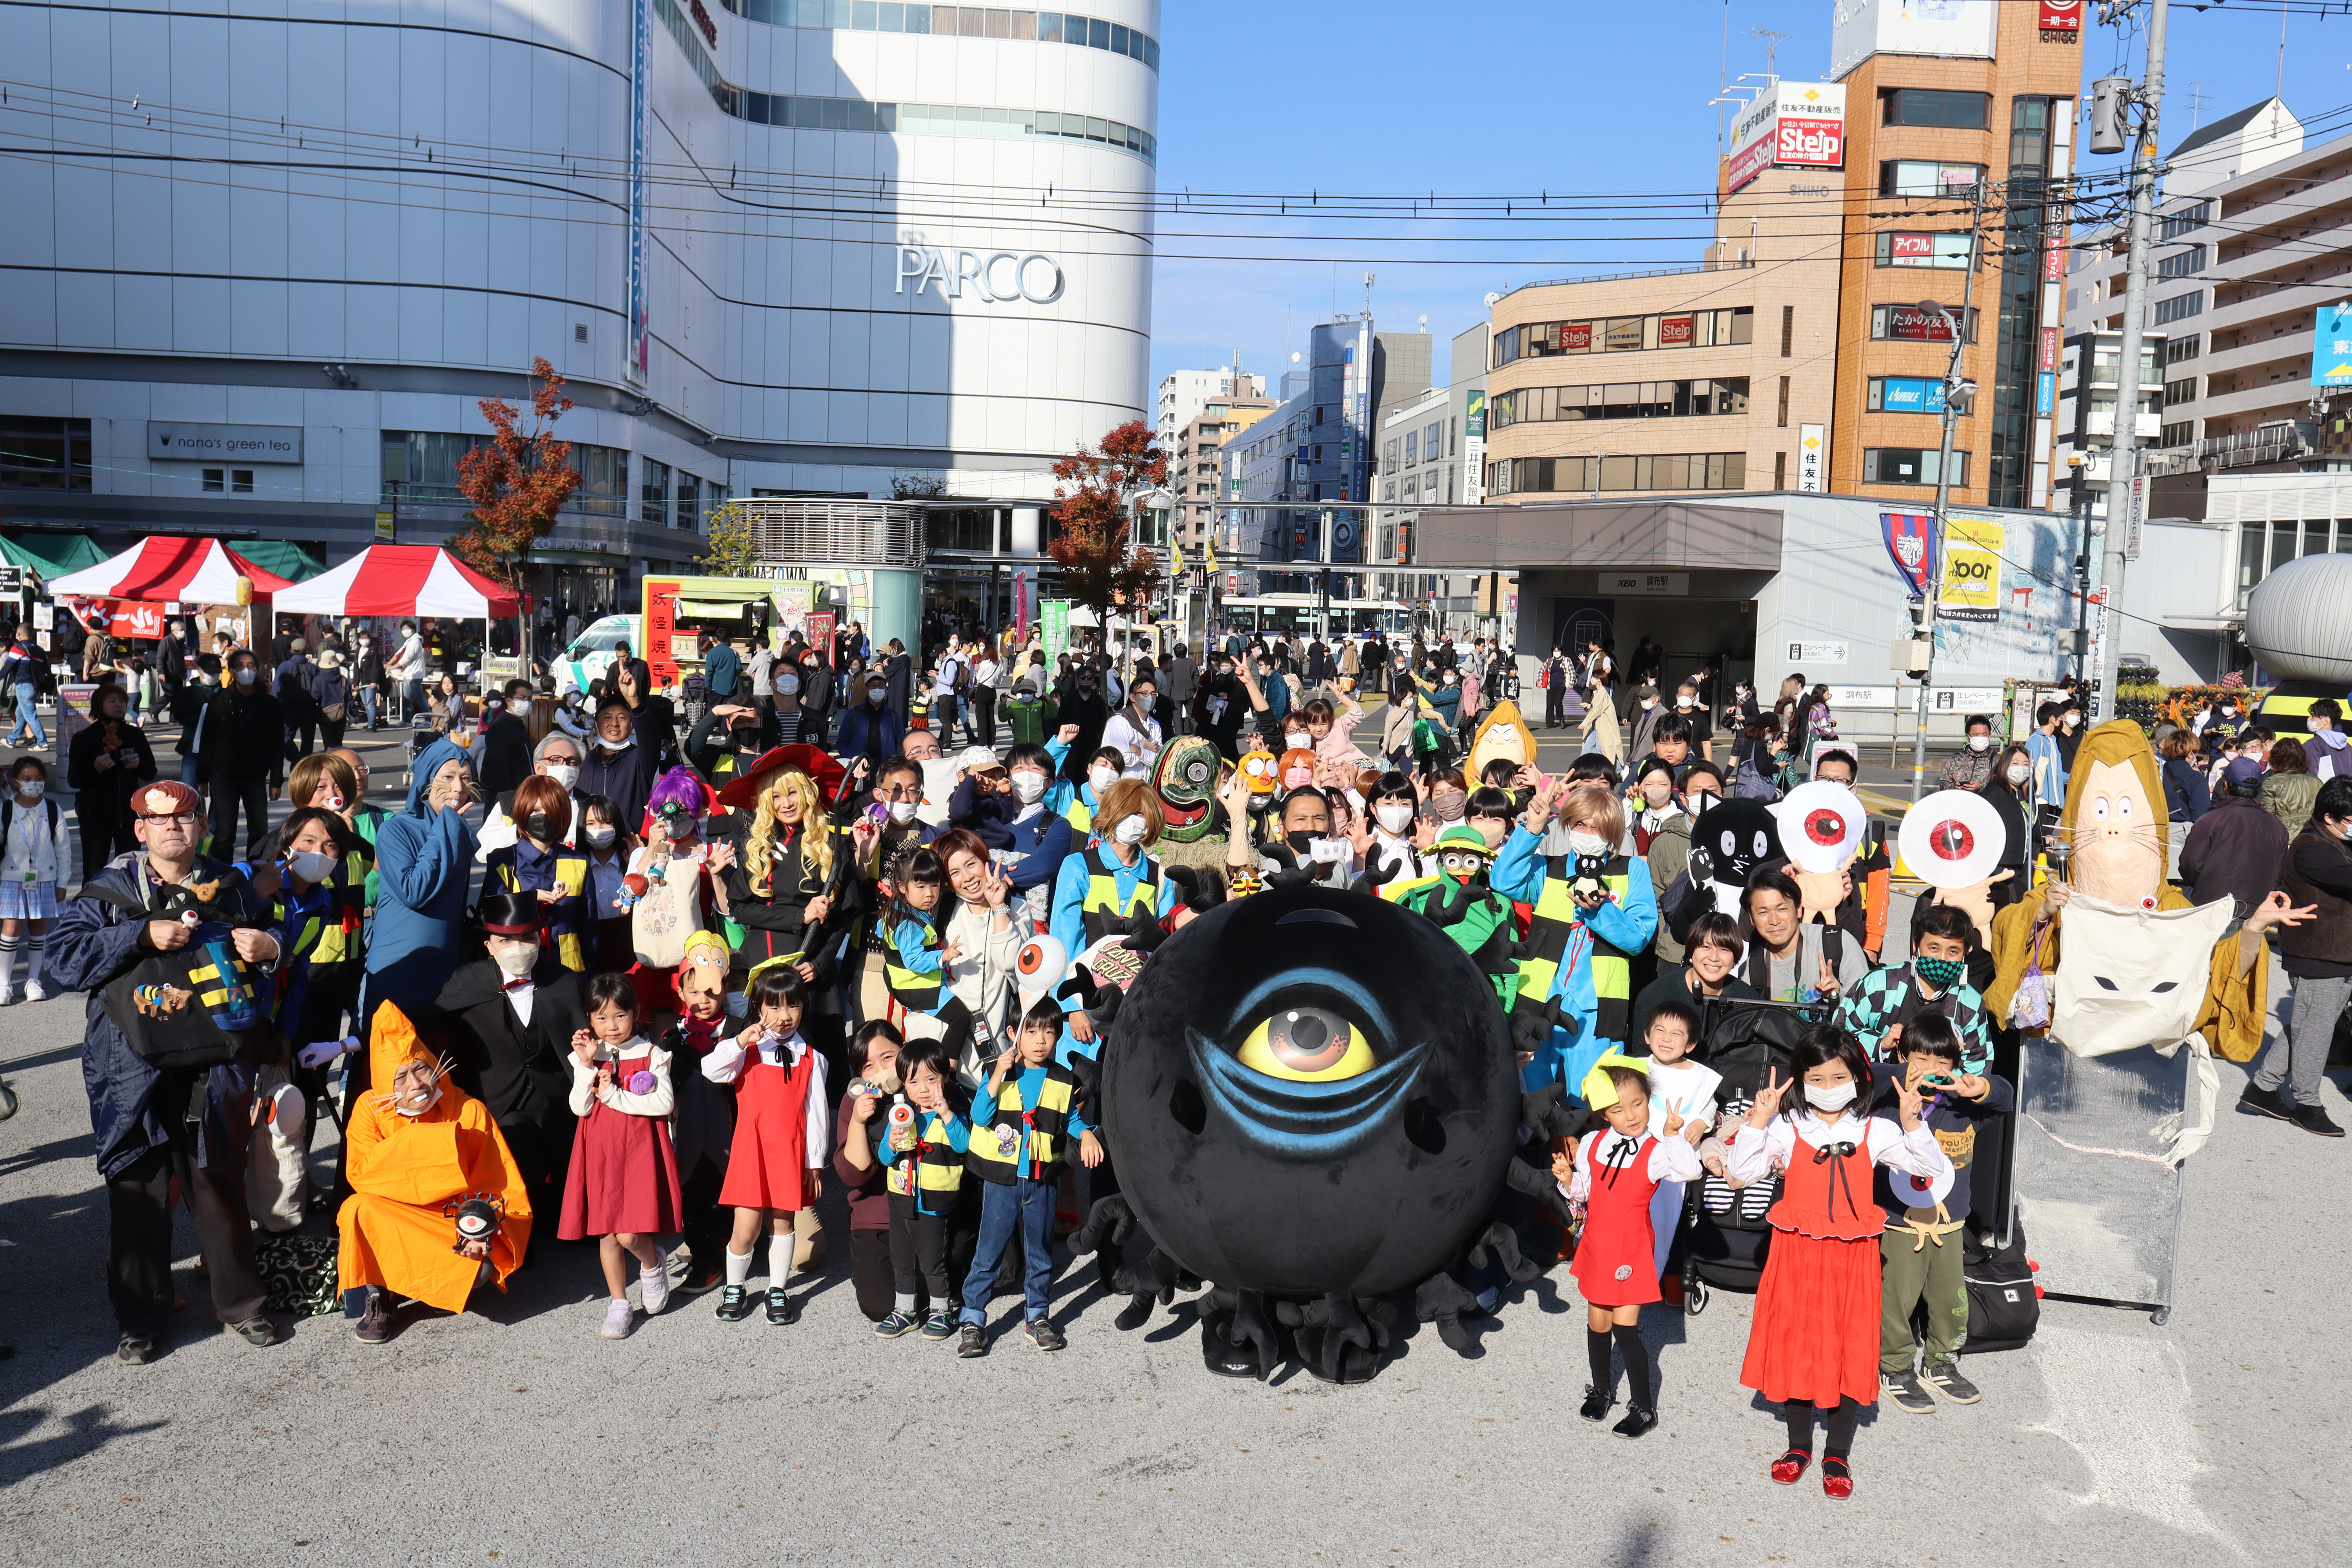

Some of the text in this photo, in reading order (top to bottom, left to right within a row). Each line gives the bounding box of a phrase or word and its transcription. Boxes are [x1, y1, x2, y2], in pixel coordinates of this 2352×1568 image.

[2042, 15, 2078, 27] 一期一会
[2040, 31, 2078, 44] ICHIGO
[1782, 104, 1841, 114] 住友不動産販売
[1740, 99, 1777, 137] 住友不動産販売
[1782, 121, 1840, 129] お住まいを信頼でおとりつぎ
[1780, 151, 1809, 160] 住友の仲介
[1729, 165, 1746, 187] 住友の仲介
[1789, 183, 1829, 197] SHINO
[1895, 237, 1930, 252] アイフル
[2049, 240, 2060, 275] アイフル
[895, 245, 1062, 301] PARCO
[2047, 331, 2055, 365] たかの友梨
[2333, 340, 2352, 355] 東
[1887, 387, 1920, 402] LIVABLE
[2042, 375, 2050, 410] 東急リバブル
[1299, 413, 1308, 445] 真光書店
[178, 436, 290, 454] nana's green tea
[1467, 441, 1479, 505] 三井住友銀行
[1804, 453, 1817, 492] 住友不
[1646, 576, 1668, 586] 調布駅
[651, 592, 667, 677] 妖怪焼き
[1846, 690, 1872, 699] 調布駅
[1091, 957, 1134, 985] CRUZ
[1940, 1134, 1973, 1147] YOU CAN
